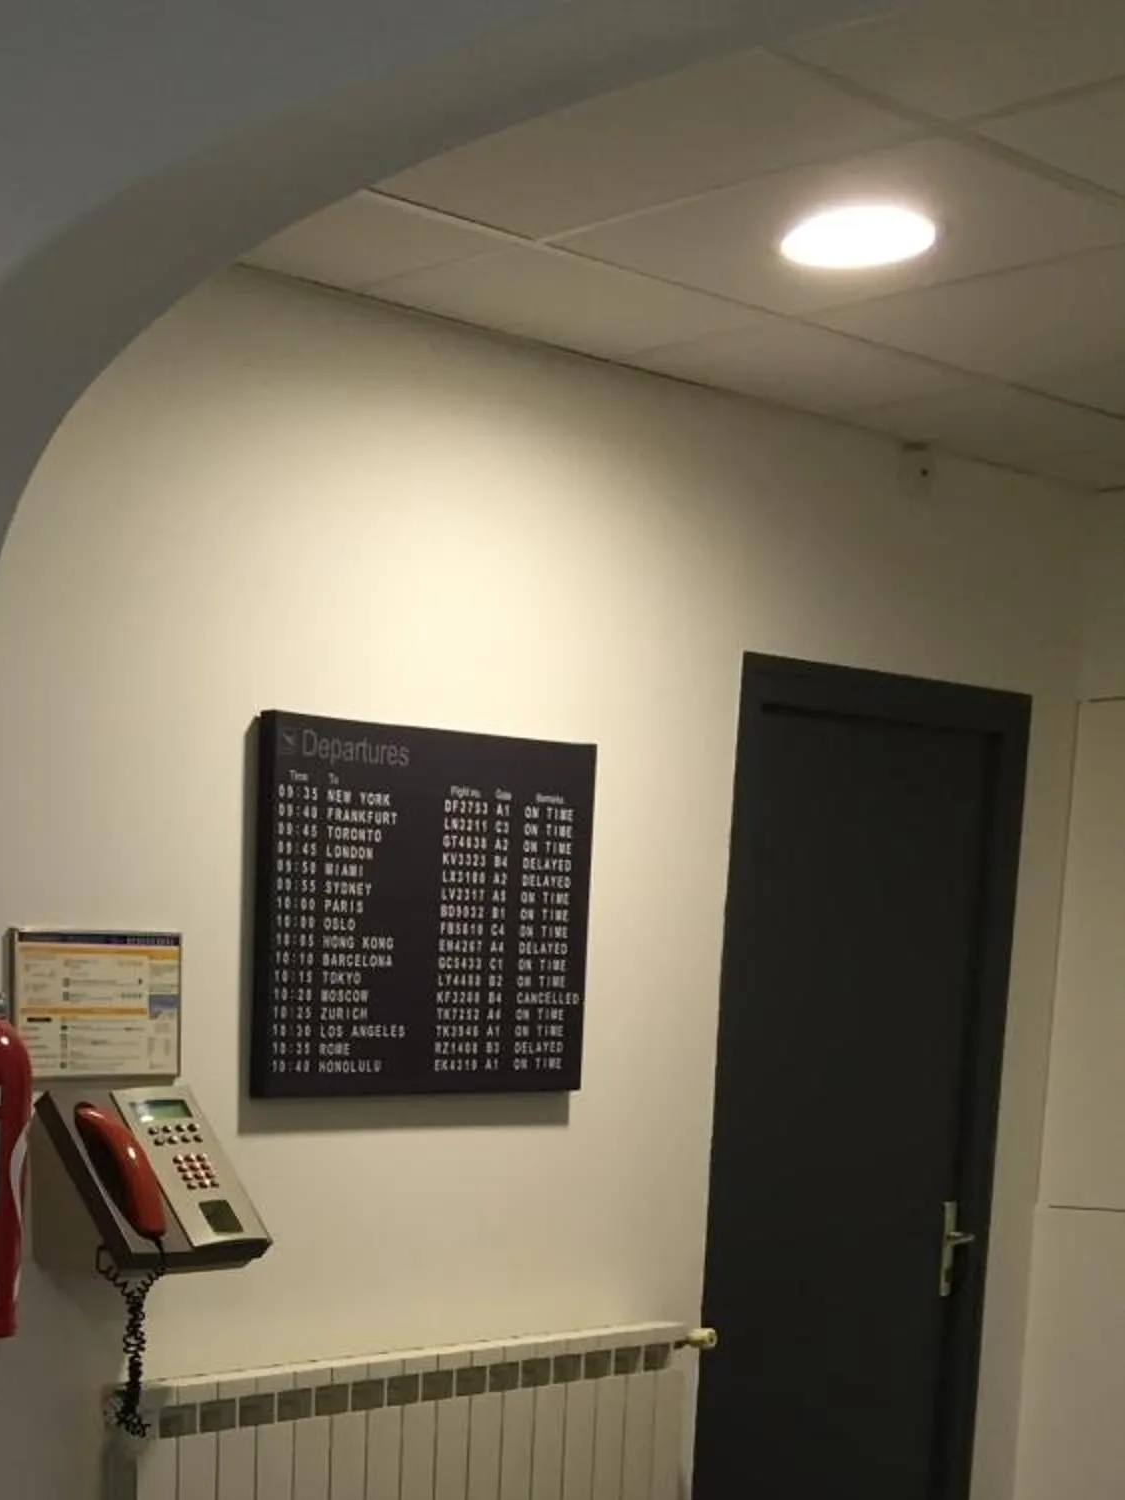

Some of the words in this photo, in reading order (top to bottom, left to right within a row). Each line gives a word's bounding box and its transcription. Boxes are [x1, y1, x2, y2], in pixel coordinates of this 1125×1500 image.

[302, 729, 410, 766] Departures
[327, 788, 351, 804] NEW
[359, 791, 390, 807] YORK
[524, 805, 539, 819] ON
[546, 806, 573, 821] TIME
[327, 806, 397, 825] FRANKFURT
[523, 823, 538, 836] ON
[545, 823, 572, 838] TIME
[326, 825, 382, 842] TORONTO
[522, 839, 537, 853] ON
[545, 840, 571, 855] TIME
[325, 844, 373, 860] LONDON
[522, 856, 572, 872] DELAYED
[324, 862, 363, 877] MIAMI
[521, 873, 571, 889] DELAYED
[324, 880, 372, 896] SYDNEY
[520, 891, 535, 904] ON
[542, 891, 569, 905] TIME
[324, 898, 363, 913] PARIS
[520, 907, 534, 920] ON
[541, 908, 568, 922] TIME
[322, 916, 356, 931] OSLO
[519, 924, 534, 937] ON
[540, 925, 568, 938] TIME
[322, 934, 355, 949] HONG
[362, 935, 394, 950] KONG
[518, 940, 568, 955] DELAYED
[322, 952, 392, 968] BARCELONA
[518, 958, 532, 971] ON
[539, 958, 565, 971] TIME
[322, 970, 361, 985] TOKYO
[516, 975, 531, 988] ON
[538, 975, 565, 988] TIME
[320, 988, 368, 1003] MOSCOW
[516, 991, 579, 1005] CANCELLED
[320, 1006, 367, 1020] ZURICH
[515, 1008, 530, 1020] ON
[537, 1007, 564, 1020] TIME
[320, 1025, 343, 1038] LOS
[351, 1024, 405, 1037] ANGELES
[514, 1024, 529, 1037] ON
[536, 1024, 563, 1037] TIME
[318, 1042, 350, 1056] ROME
[514, 1041, 563, 1054] DELAYED
[318, 1059, 381, 1073] HONOLULU
[513, 1057, 527, 1070] ON
[535, 1057, 561, 1069] TIME
